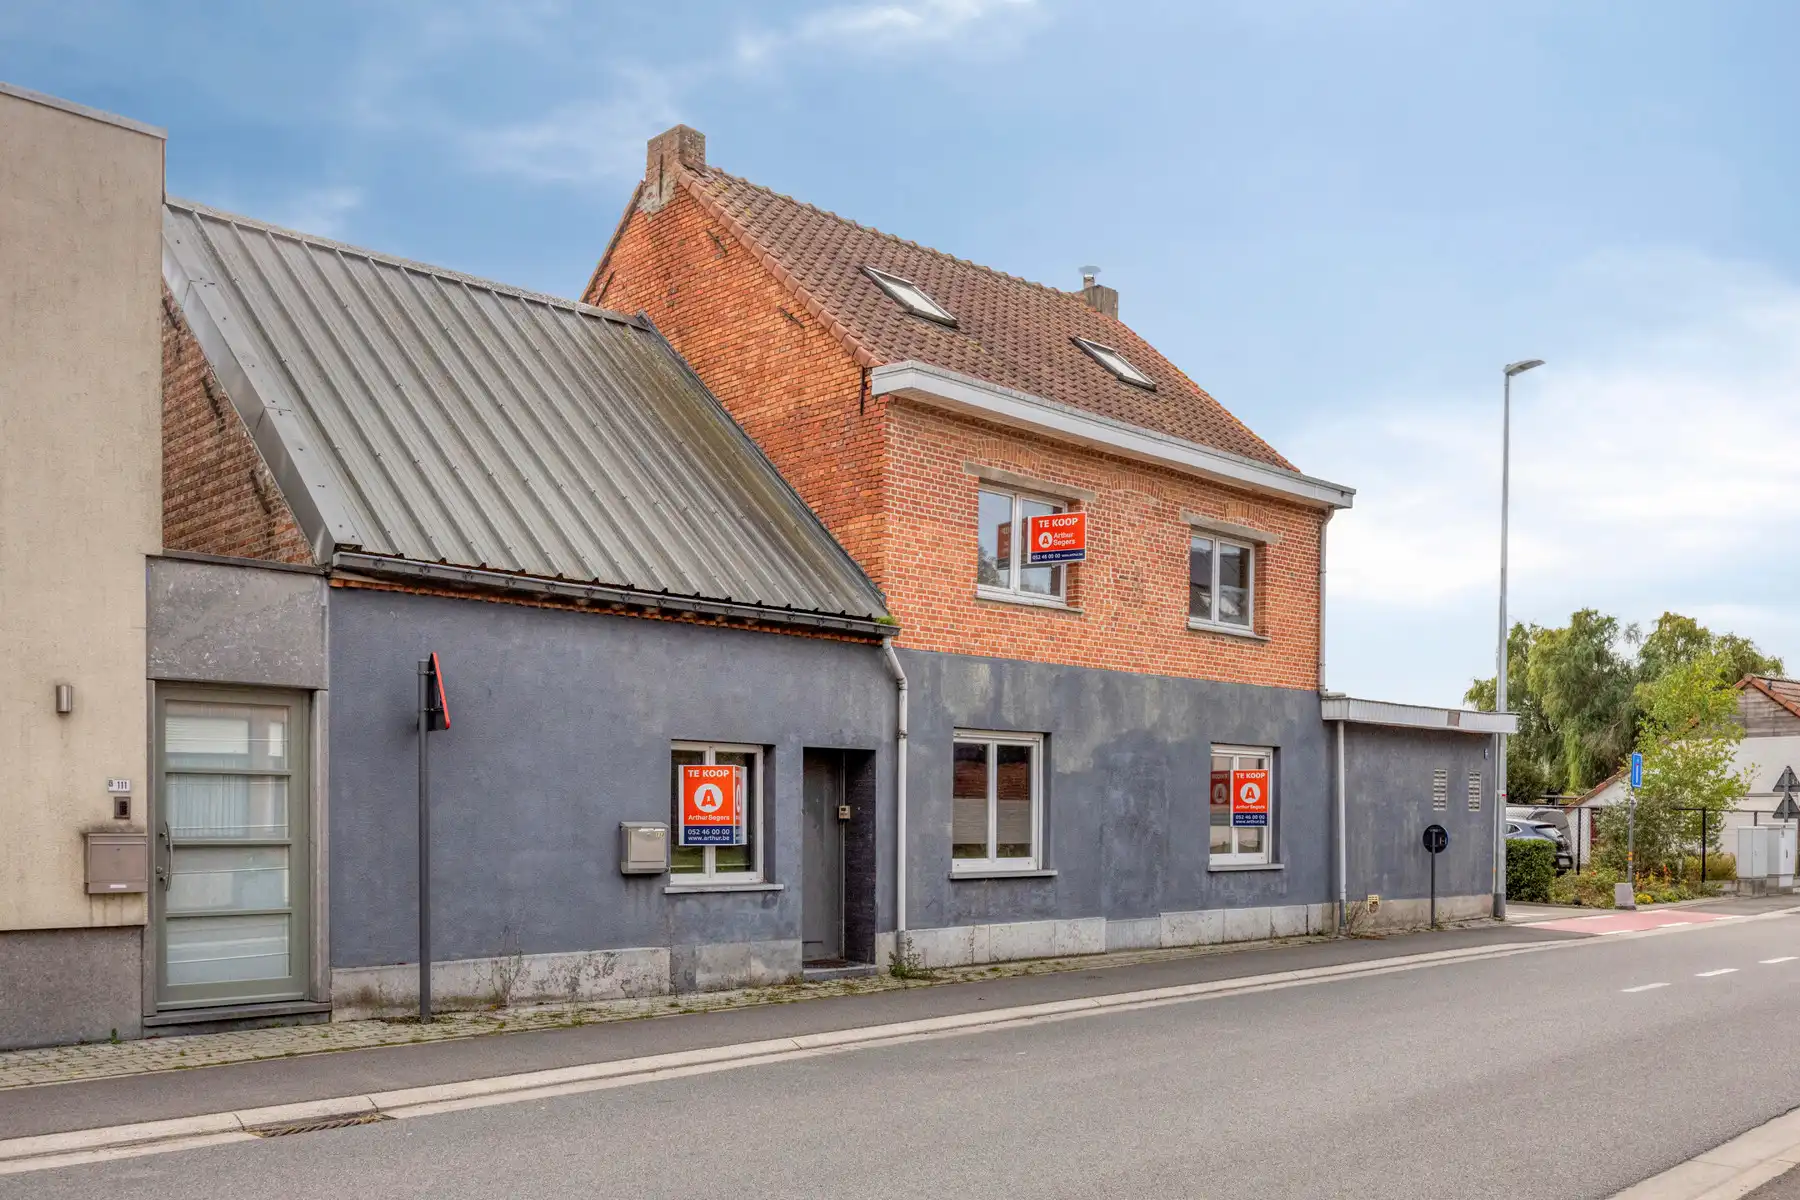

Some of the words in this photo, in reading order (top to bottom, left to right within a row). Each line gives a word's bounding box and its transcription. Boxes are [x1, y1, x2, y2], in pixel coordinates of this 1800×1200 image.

[1038, 519, 1050, 528] TE
[1052, 517, 1078, 527] KOOP
[688, 769, 700, 778] TE
[703, 769, 730, 778] KOOP
[117, 781, 127, 789] 111
[708, 814, 730, 822] Segers
